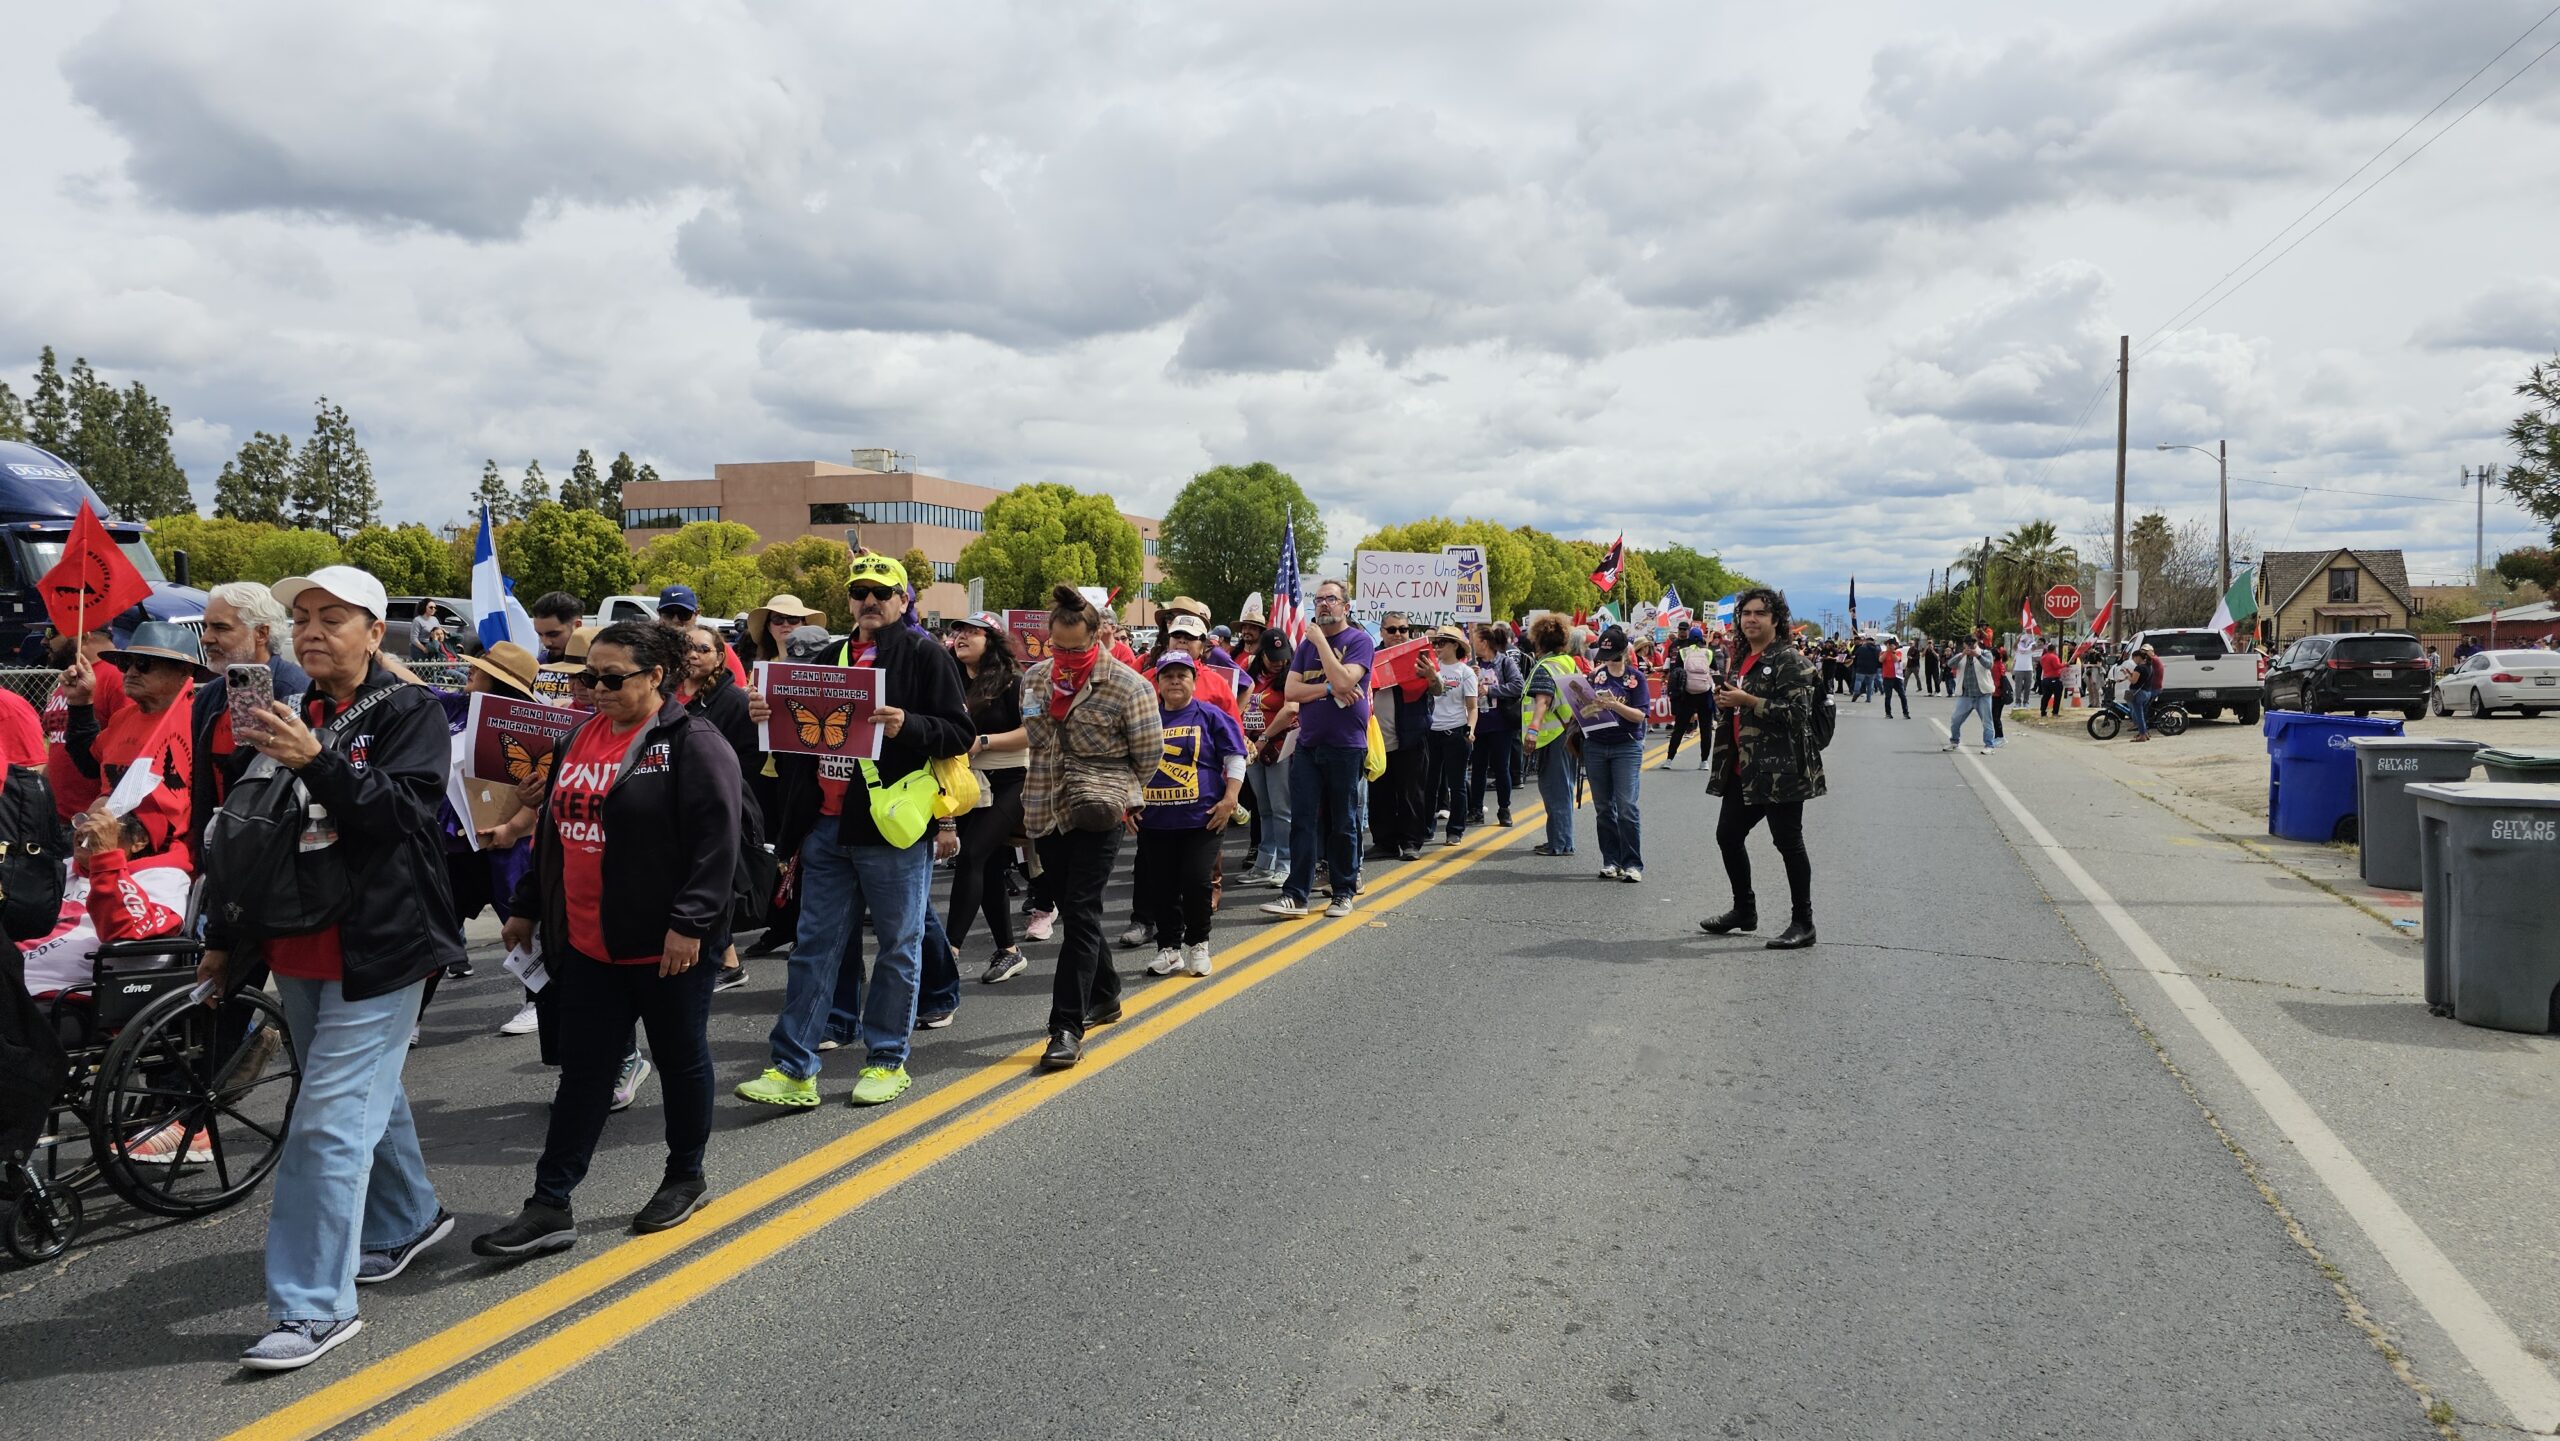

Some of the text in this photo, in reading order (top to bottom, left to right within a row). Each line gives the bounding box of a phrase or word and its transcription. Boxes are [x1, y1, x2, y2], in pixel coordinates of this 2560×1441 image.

[1362, 555, 1456, 577] Somos Una
[1363, 581, 1448, 598] NACION
[1457, 583, 1480, 593] ORKERS
[1371, 601, 1385, 609] DE
[2047, 595, 2079, 608] STOP
[792, 671, 846, 683] STAND WITH
[773, 685, 868, 700] IMMIGRANT WORKERS
[510, 706, 573, 725] STAND WITH
[487, 716, 542, 736] IMMIGRANT
[350, 734, 375, 751] NIT
[558, 762, 622, 792] UNIT
[634, 766, 657, 775] OCAL
[1145, 788, 1195, 800] JANITORS
[553, 790, 604, 822] HER
[2492, 819, 2556, 831] CITY OF
[2491, 829, 2556, 841] DELANO
[123, 983, 152, 994] drive
